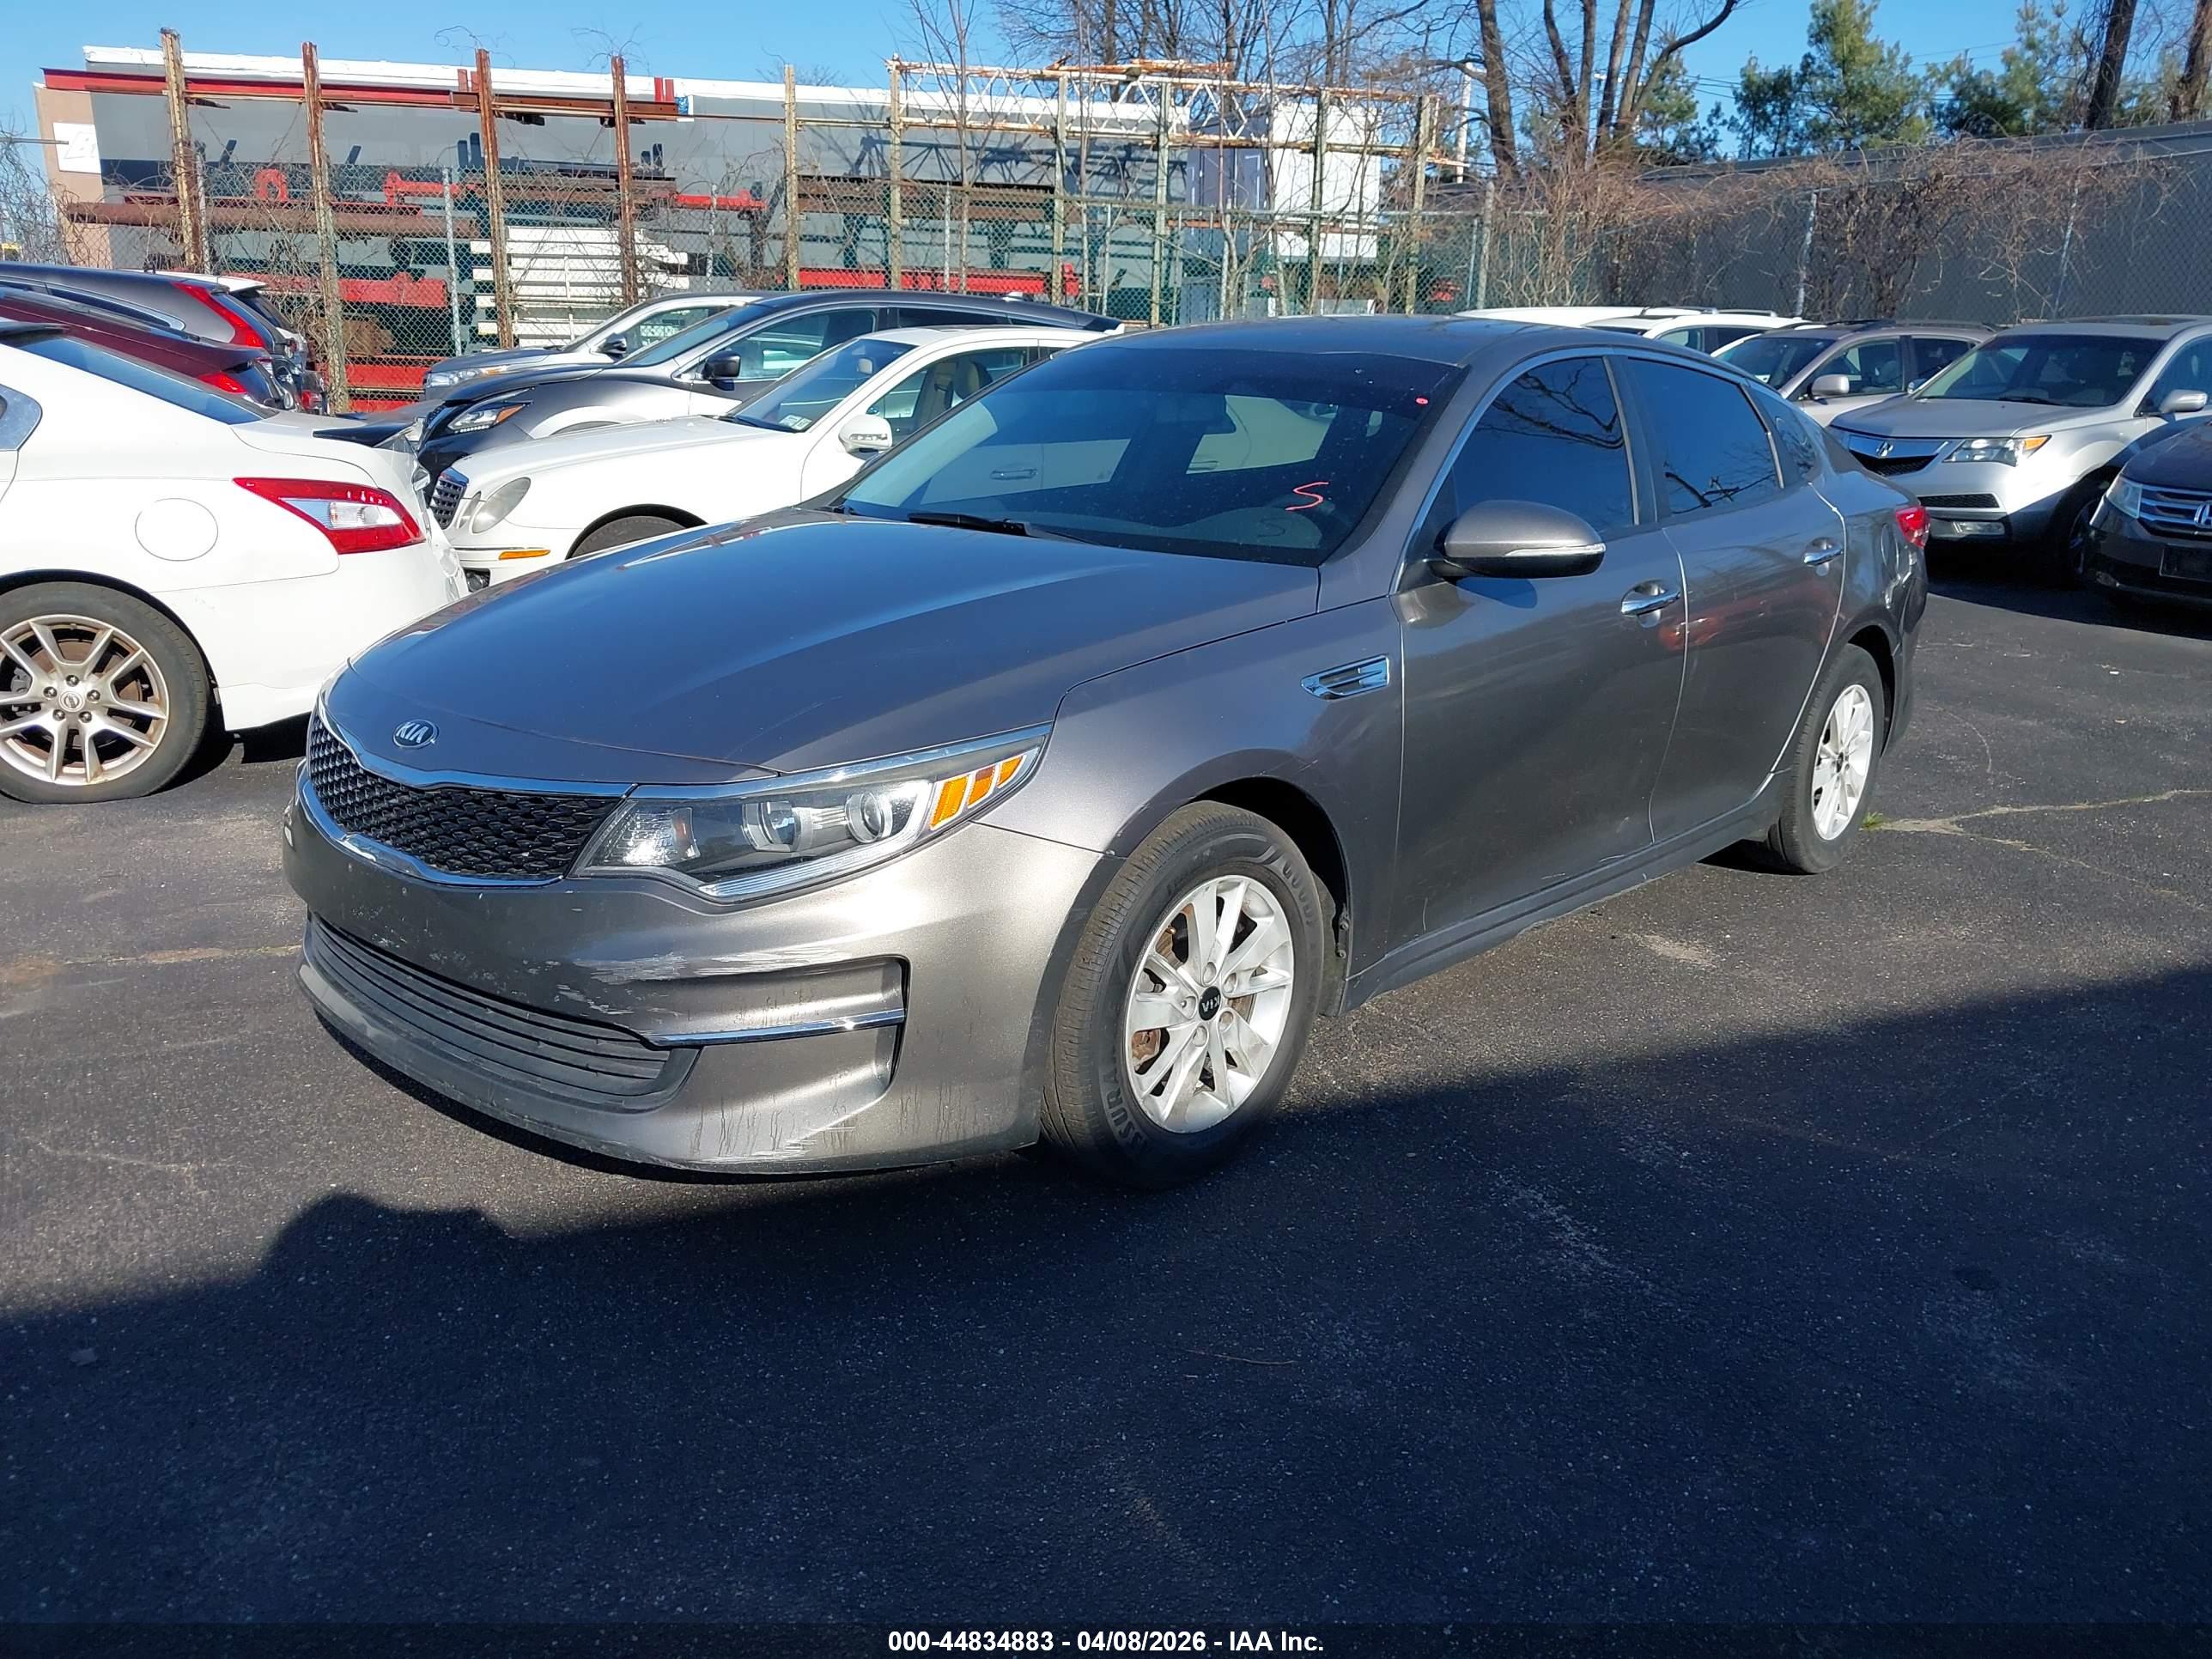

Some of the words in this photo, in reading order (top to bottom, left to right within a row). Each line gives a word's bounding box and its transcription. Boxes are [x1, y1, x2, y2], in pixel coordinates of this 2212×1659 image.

[1284, 481, 1329, 511] S
[395, 721, 429, 744] KIA
[1201, 994, 1220, 1012] KIA
